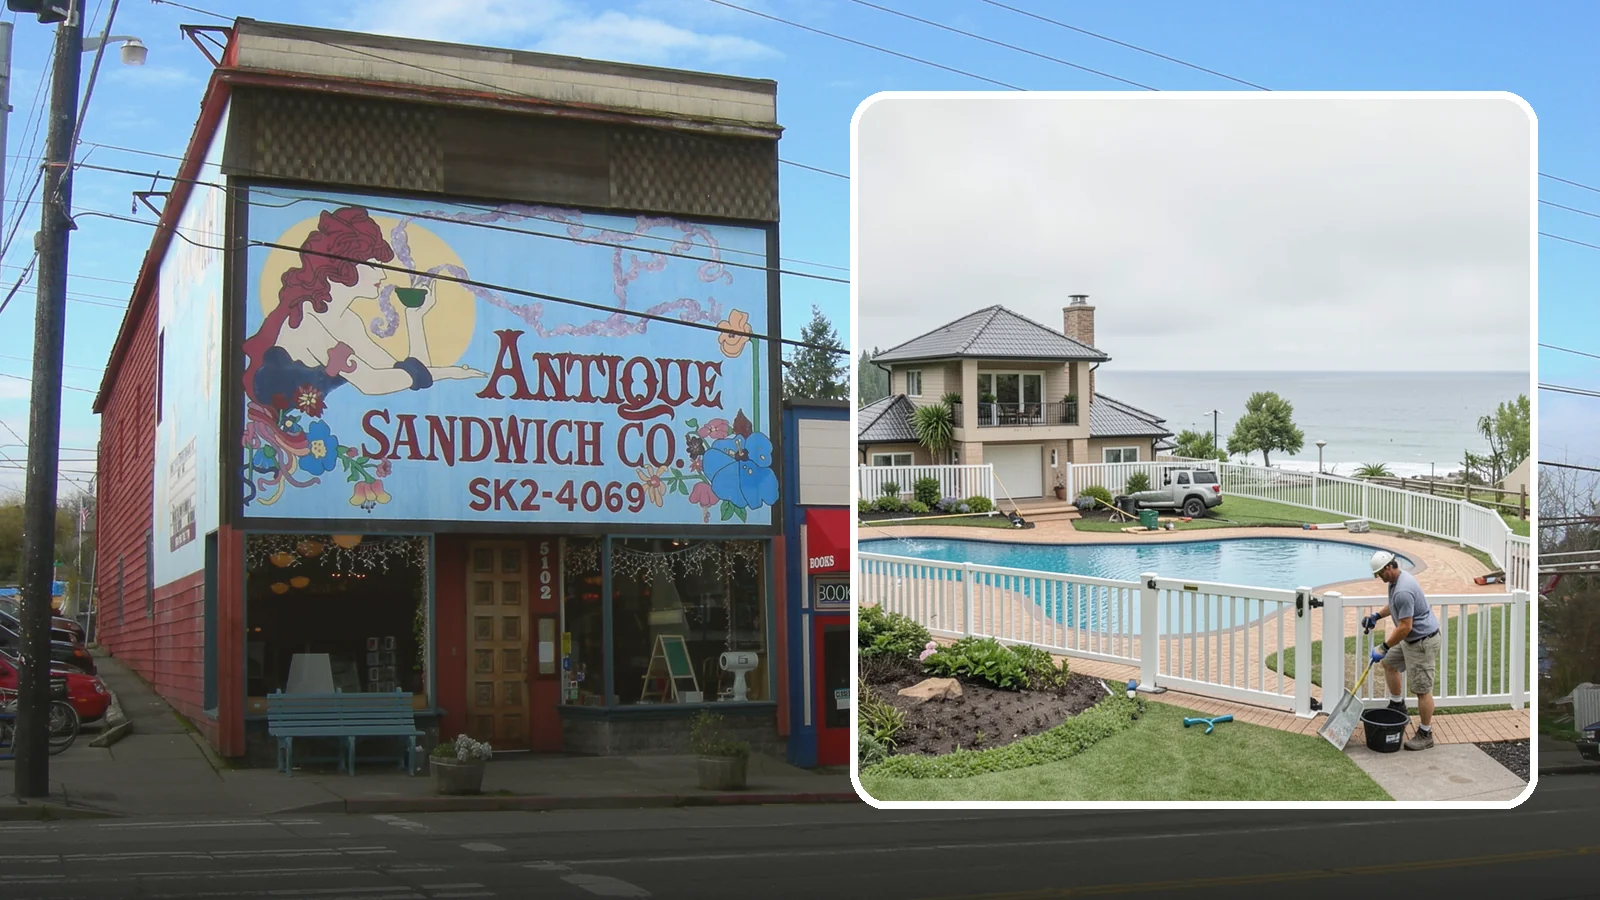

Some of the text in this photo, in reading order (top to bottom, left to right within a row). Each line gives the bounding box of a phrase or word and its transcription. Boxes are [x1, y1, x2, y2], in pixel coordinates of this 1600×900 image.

[476, 329, 723, 420] ANTIQUE
[362, 409, 685, 470] SANDWICH CO.
[469, 476, 646, 513] SK2-4069
[540, 542, 552, 599] 5102
[809, 555, 835, 569] BOOKS
